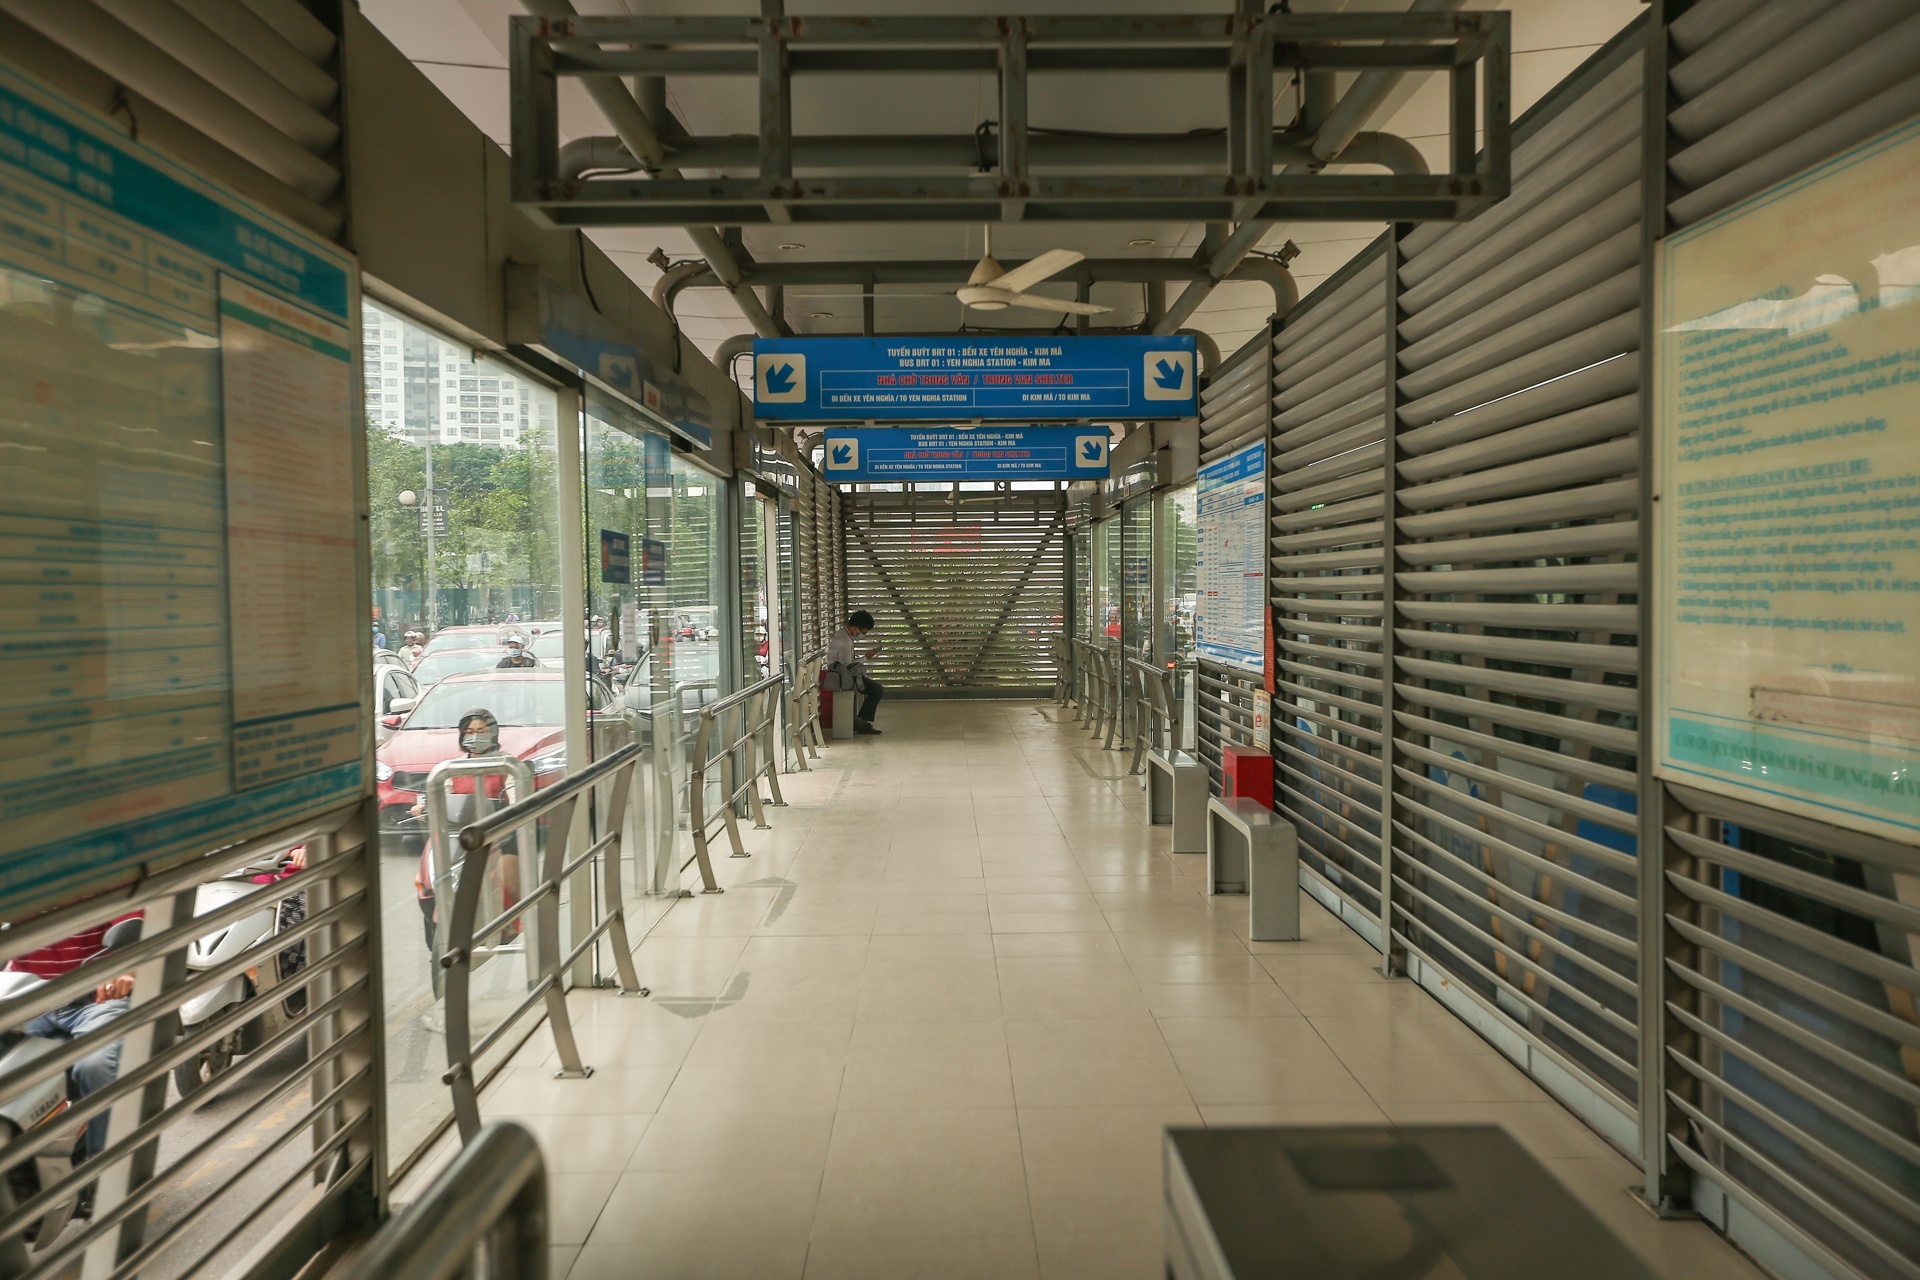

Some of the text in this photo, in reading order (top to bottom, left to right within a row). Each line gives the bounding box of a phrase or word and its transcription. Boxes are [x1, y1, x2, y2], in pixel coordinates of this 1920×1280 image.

[887, 346, 910, 356] TUYẾN
[912, 347, 930, 356] BUÝT
[931, 348, 945, 356] BRT
[962, 346, 976, 356] BẾN
[989, 346, 1004, 355] YÊN
[1005, 346, 1027, 355] NGHĨA
[1050, 346, 1062, 355] MÃ
[899, 358, 914, 366] BUS
[986, 358, 1016, 366] STATION
[877, 373, 896, 385] NHÀ
[899, 373, 918, 385] CHỜ
[919, 375, 948, 385] TRUNG
[951, 373, 969, 385] VĂN
[982, 374, 1012, 384] TRUNG
[1014, 374, 1032, 384] VAN
[1034, 374, 1073, 384] SHELTER
[839, 393, 852, 402] BẾN
